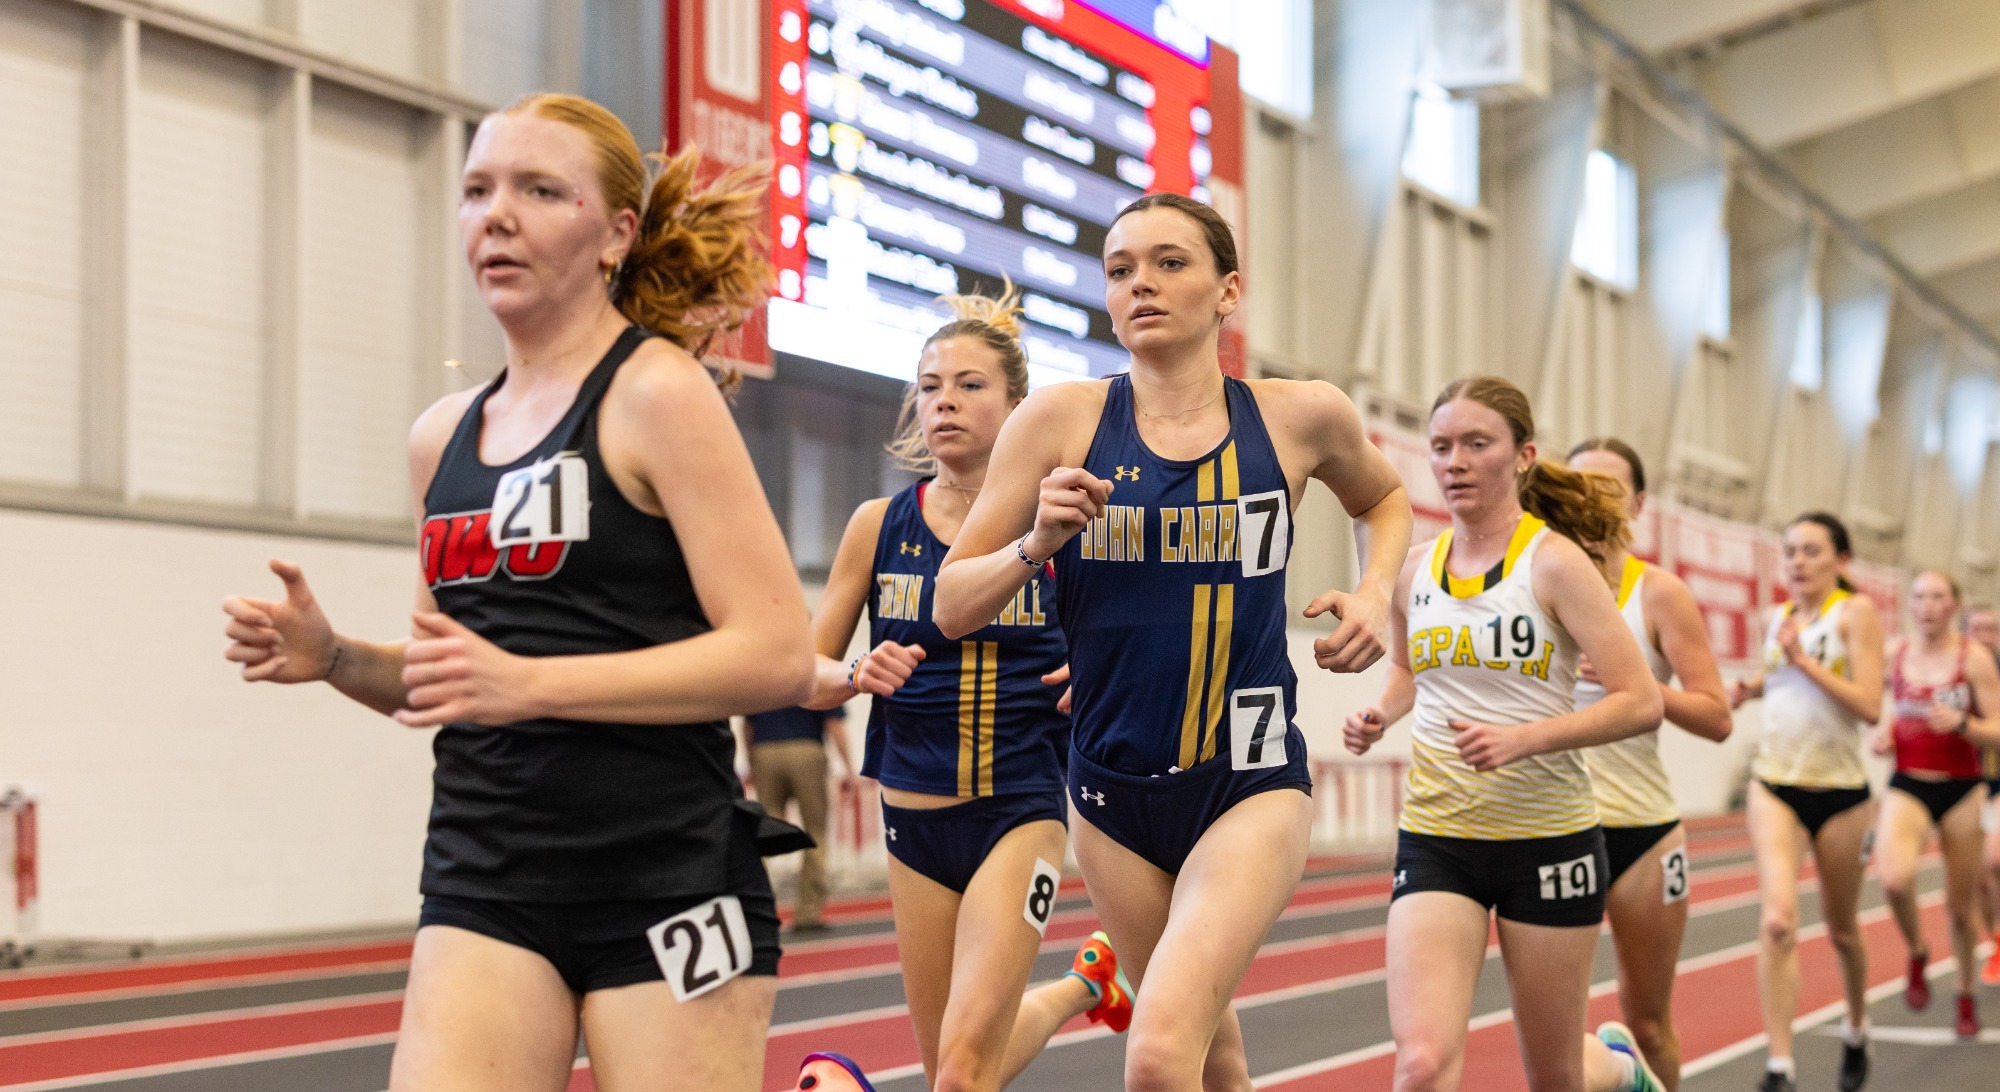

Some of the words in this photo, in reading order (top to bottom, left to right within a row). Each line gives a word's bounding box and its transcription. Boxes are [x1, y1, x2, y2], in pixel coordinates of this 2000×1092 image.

[500, 463, 563, 540] 21
[1081, 505, 1145, 562] JOHN
[1245, 497, 1280, 570] 7
[1487, 614, 1536, 659] 19
[1236, 692, 1277, 764] 7
[1028, 873, 1055, 924] 8
[1545, 861, 1590, 899] 19
[1668, 853, 1686, 897] 3
[662, 901, 739, 995] 21
